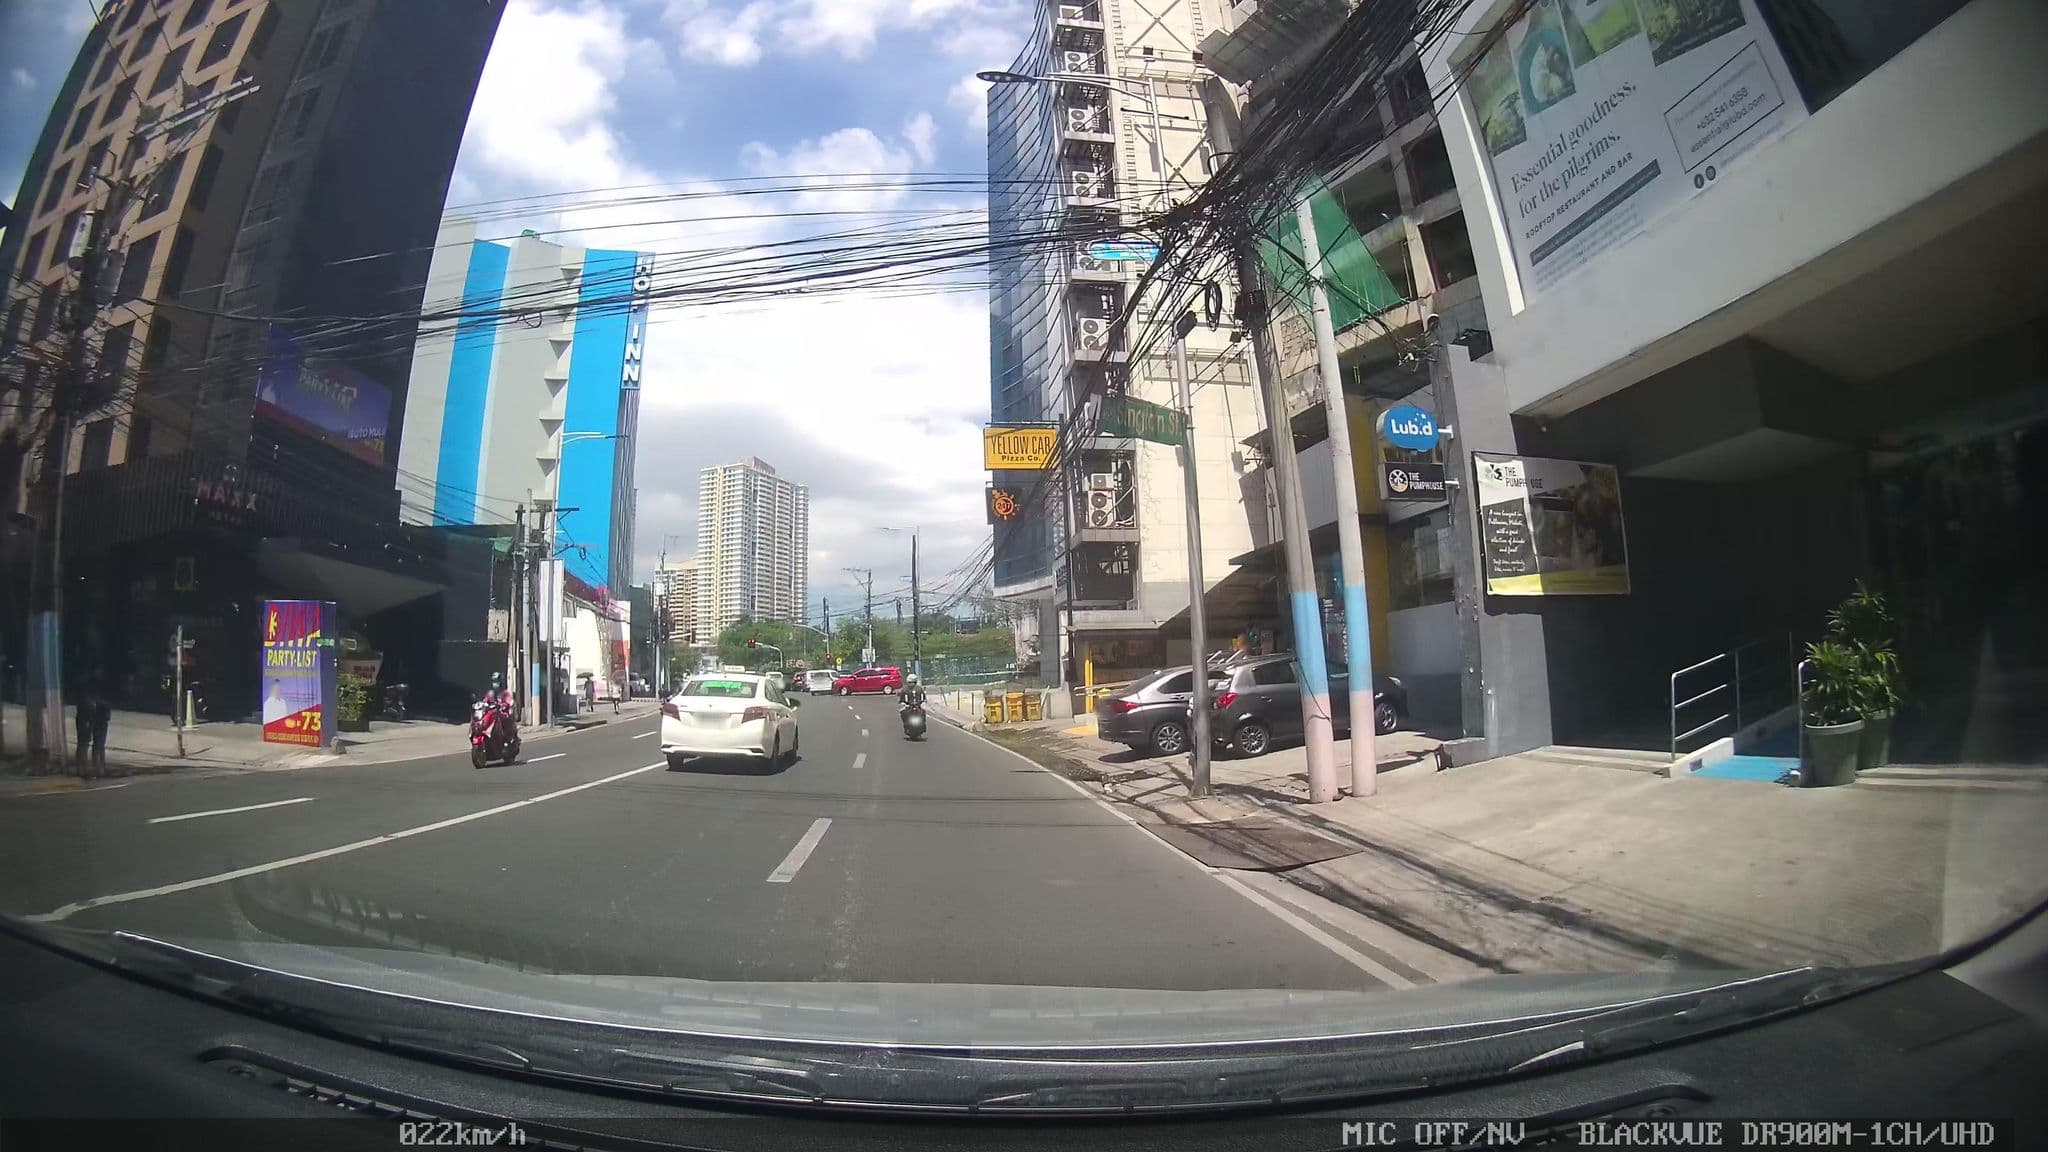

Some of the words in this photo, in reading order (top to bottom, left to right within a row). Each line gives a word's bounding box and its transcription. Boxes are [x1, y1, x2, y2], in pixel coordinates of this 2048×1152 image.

[1511, 132, 1568, 193] Essential
[1568, 80, 1637, 151] goodness.
[1519, 195, 1538, 219] for
[1540, 177, 1561, 202] the
[1561, 130, 1621, 189] pilgrims.
[1525, 212, 1556, 239] ROOFTOP
[1557, 178, 1600, 216] RESTAURANT
[1601, 165, 1617, 181] AND
[1617, 152, 1633, 168] BAR
[623, 323, 641, 383] INN
[991, 436, 1029, 455] YELLOW
[1408, 472, 1420, 481] THE
[1504, 466, 1517, 477] THE
[1505, 477, 1543, 489] PUMPHUSE
[266, 649, 318, 668] PARTY-LIST
